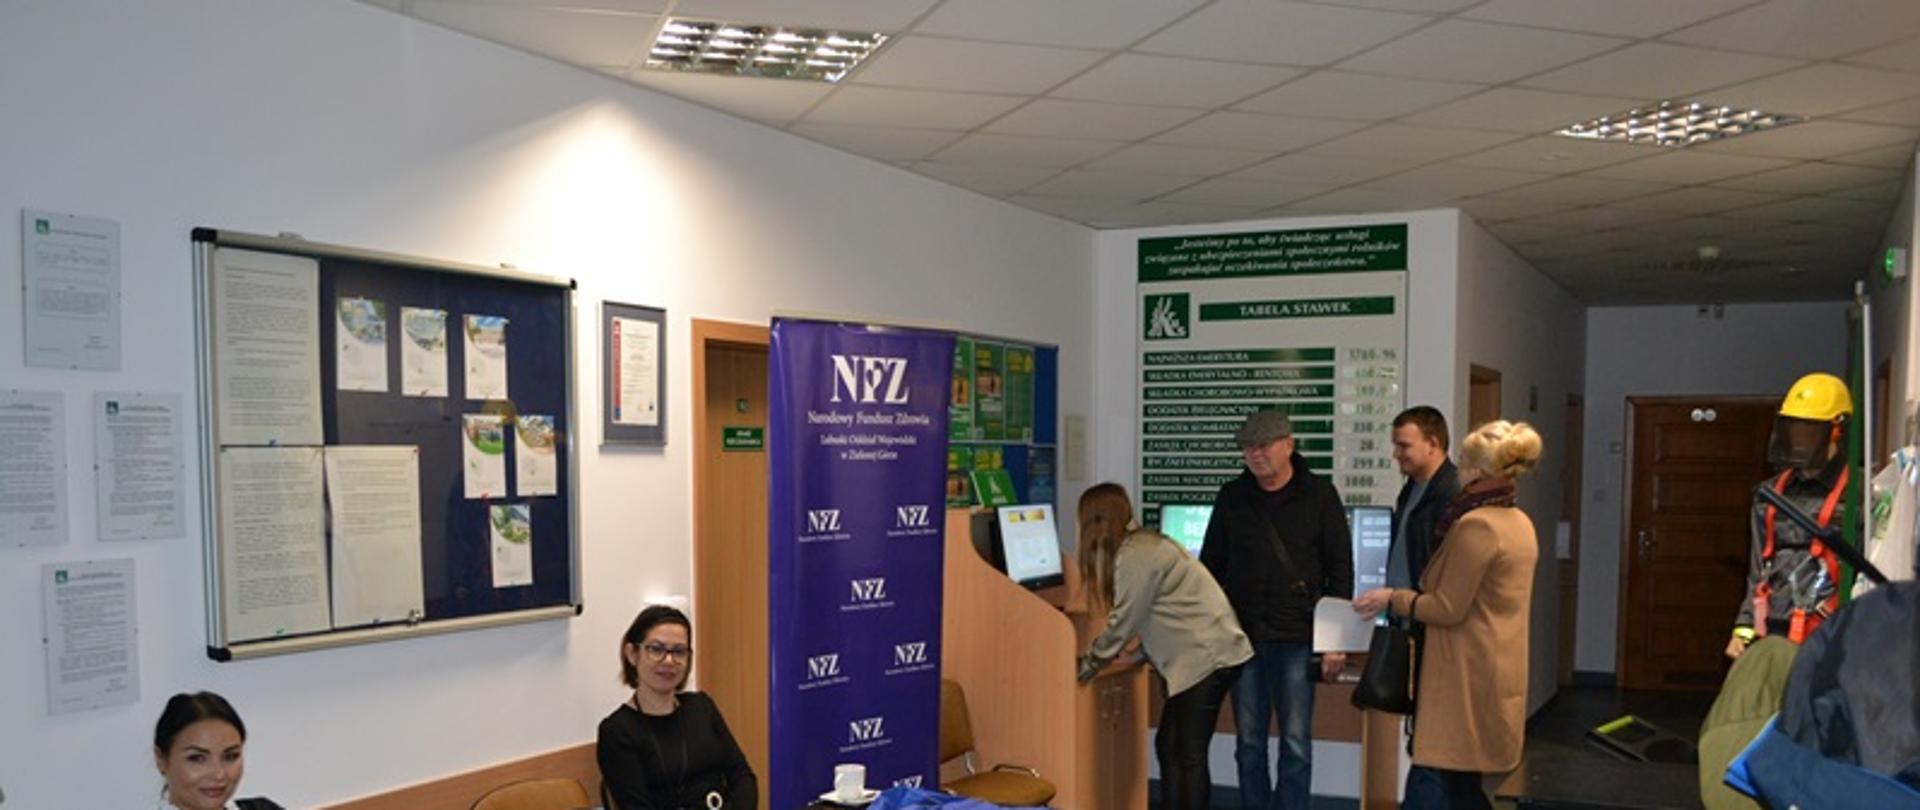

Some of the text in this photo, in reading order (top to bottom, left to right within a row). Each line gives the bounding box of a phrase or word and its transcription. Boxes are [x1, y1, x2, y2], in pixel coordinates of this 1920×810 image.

[1240, 301, 1351, 317] TABELA STAWEK
[830, 355, 910, 404] NFZ
[808, 411, 930, 427] Narodowy Fundusz Zdrowia
[808, 509, 841, 532] NFZ
[897, 505, 929, 528] NFZ
[851, 578, 886, 602] NFZ
[894, 642, 927, 665] NFZ
[808, 653, 840, 680] NFZ
[850, 717, 884, 742] NFZ
